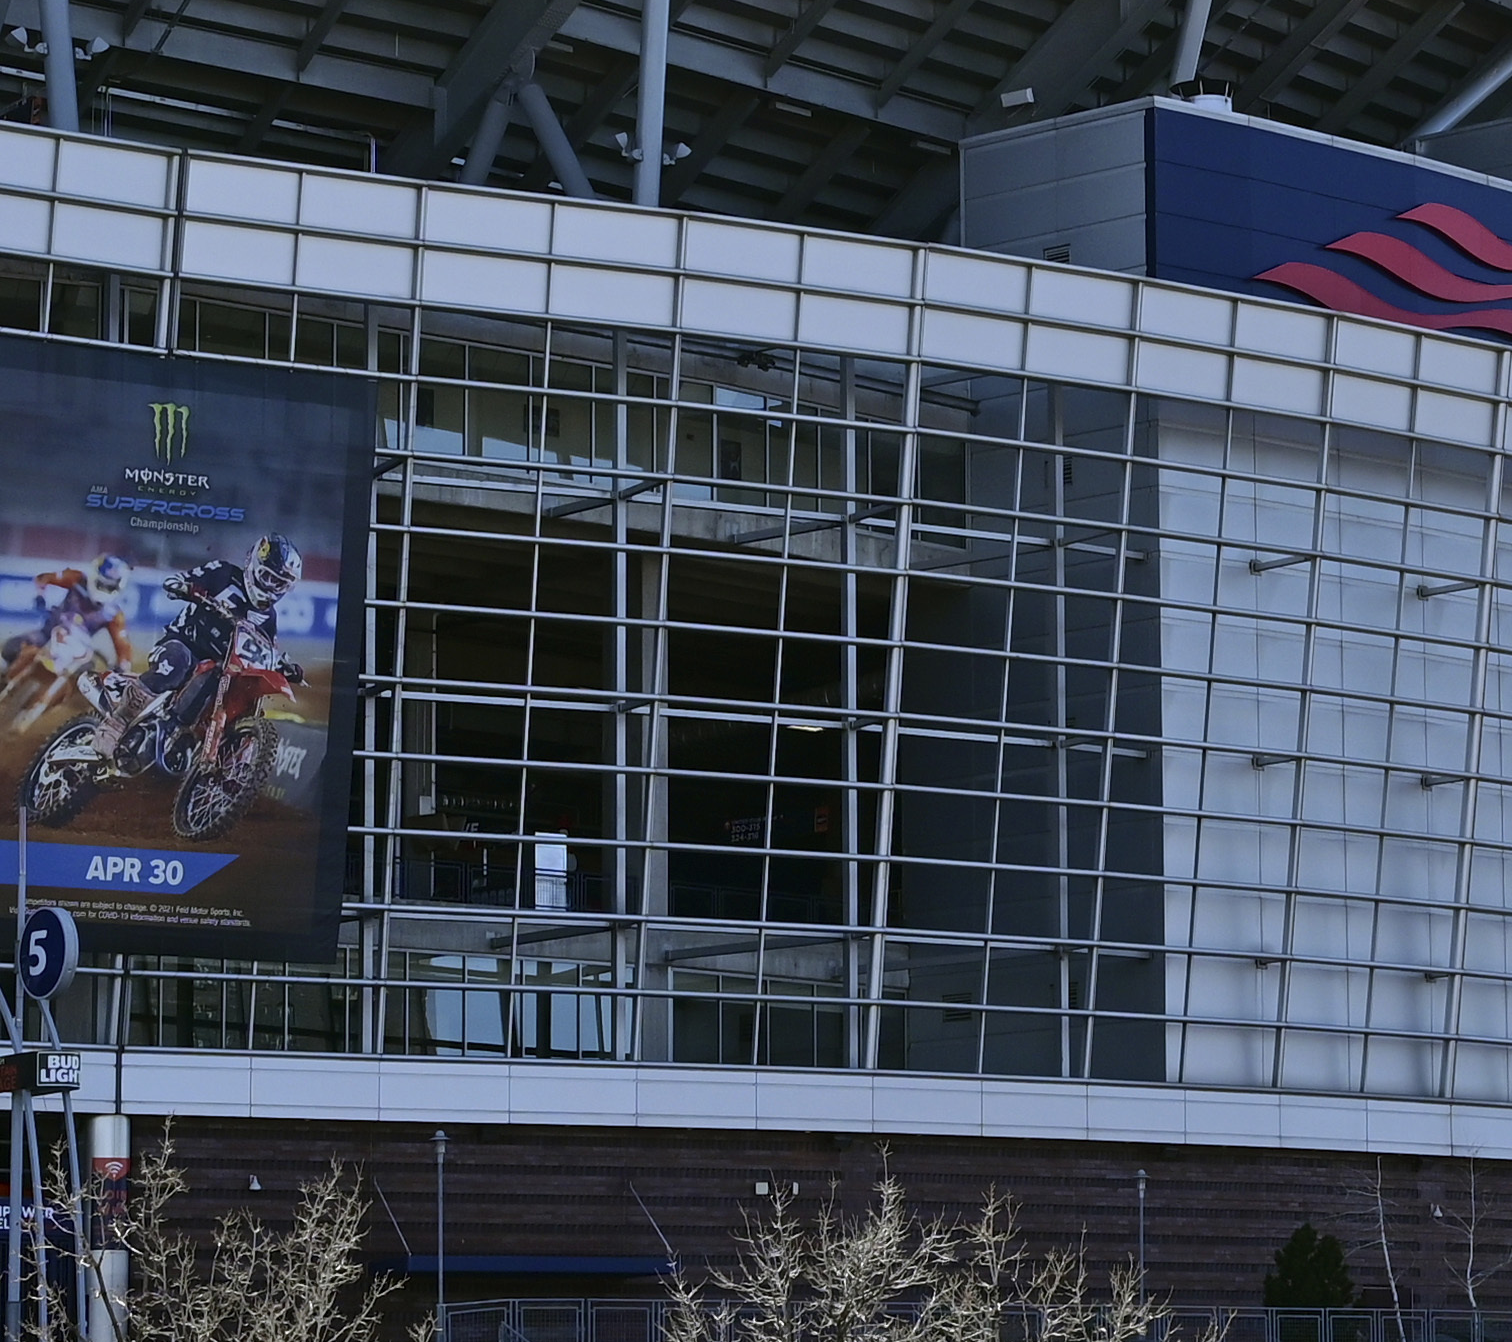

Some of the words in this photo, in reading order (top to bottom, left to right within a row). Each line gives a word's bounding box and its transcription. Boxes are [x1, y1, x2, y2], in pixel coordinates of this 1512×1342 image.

[125, 468, 210, 489] MONSTER
[85, 494, 245, 522] SUPERCROSS
[130, 516, 199, 534] Championship
[86, 855, 141, 883] APR
[148, 859, 184, 885] 30
[25, 898, 56, 907] ompetitors
[92, 900, 114, 910] subject
[28, 930, 47, 976] 5
[48, 1055, 79, 1069] BUD
